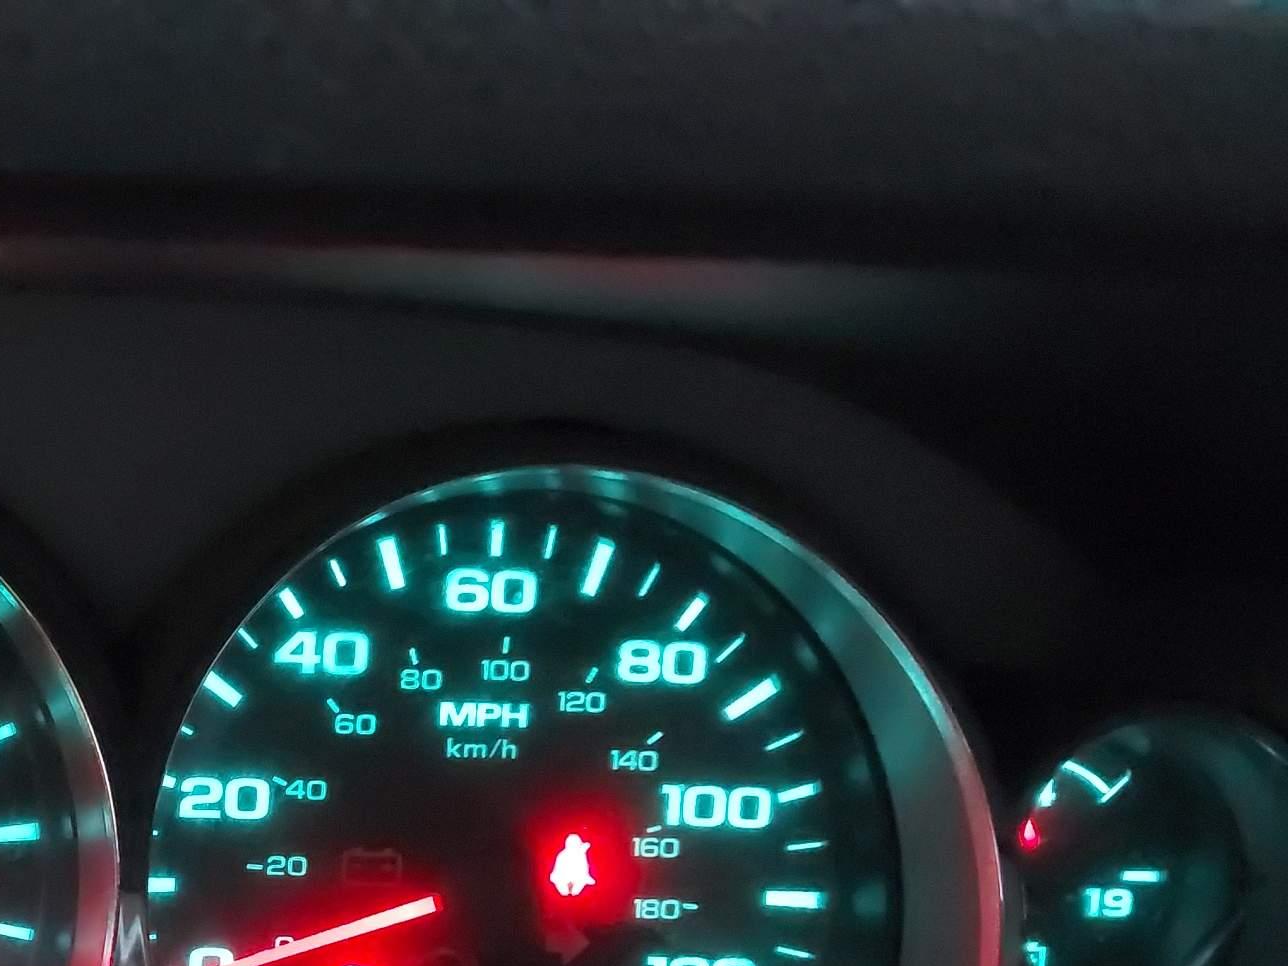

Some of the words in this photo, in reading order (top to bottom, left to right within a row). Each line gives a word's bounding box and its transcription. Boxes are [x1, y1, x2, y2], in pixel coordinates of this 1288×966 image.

[445, 567, 538, 614] 60
[273, 630, 369, 675] 40
[617, 640, 707, 684] 80
[400, 669, 443, 690] 80
[481, 660, 530, 681] 100
[557, 691, 606, 713] 120
[334, 714, 377, 735] 60
[439, 701, 530, 728] MPH
[446, 738, 518, 760] km/h
[610, 749, 658, 772] 140
[178, 776, 270, 820] 20
[285, 780, 327, 800] 40
[661, 783, 774, 829] 100
[632, 837, 680, 859] 160
[266, 855, 308, 877] 20
[634, 899, 680, 920] 180
[1081, 887, 1133, 918] 19
